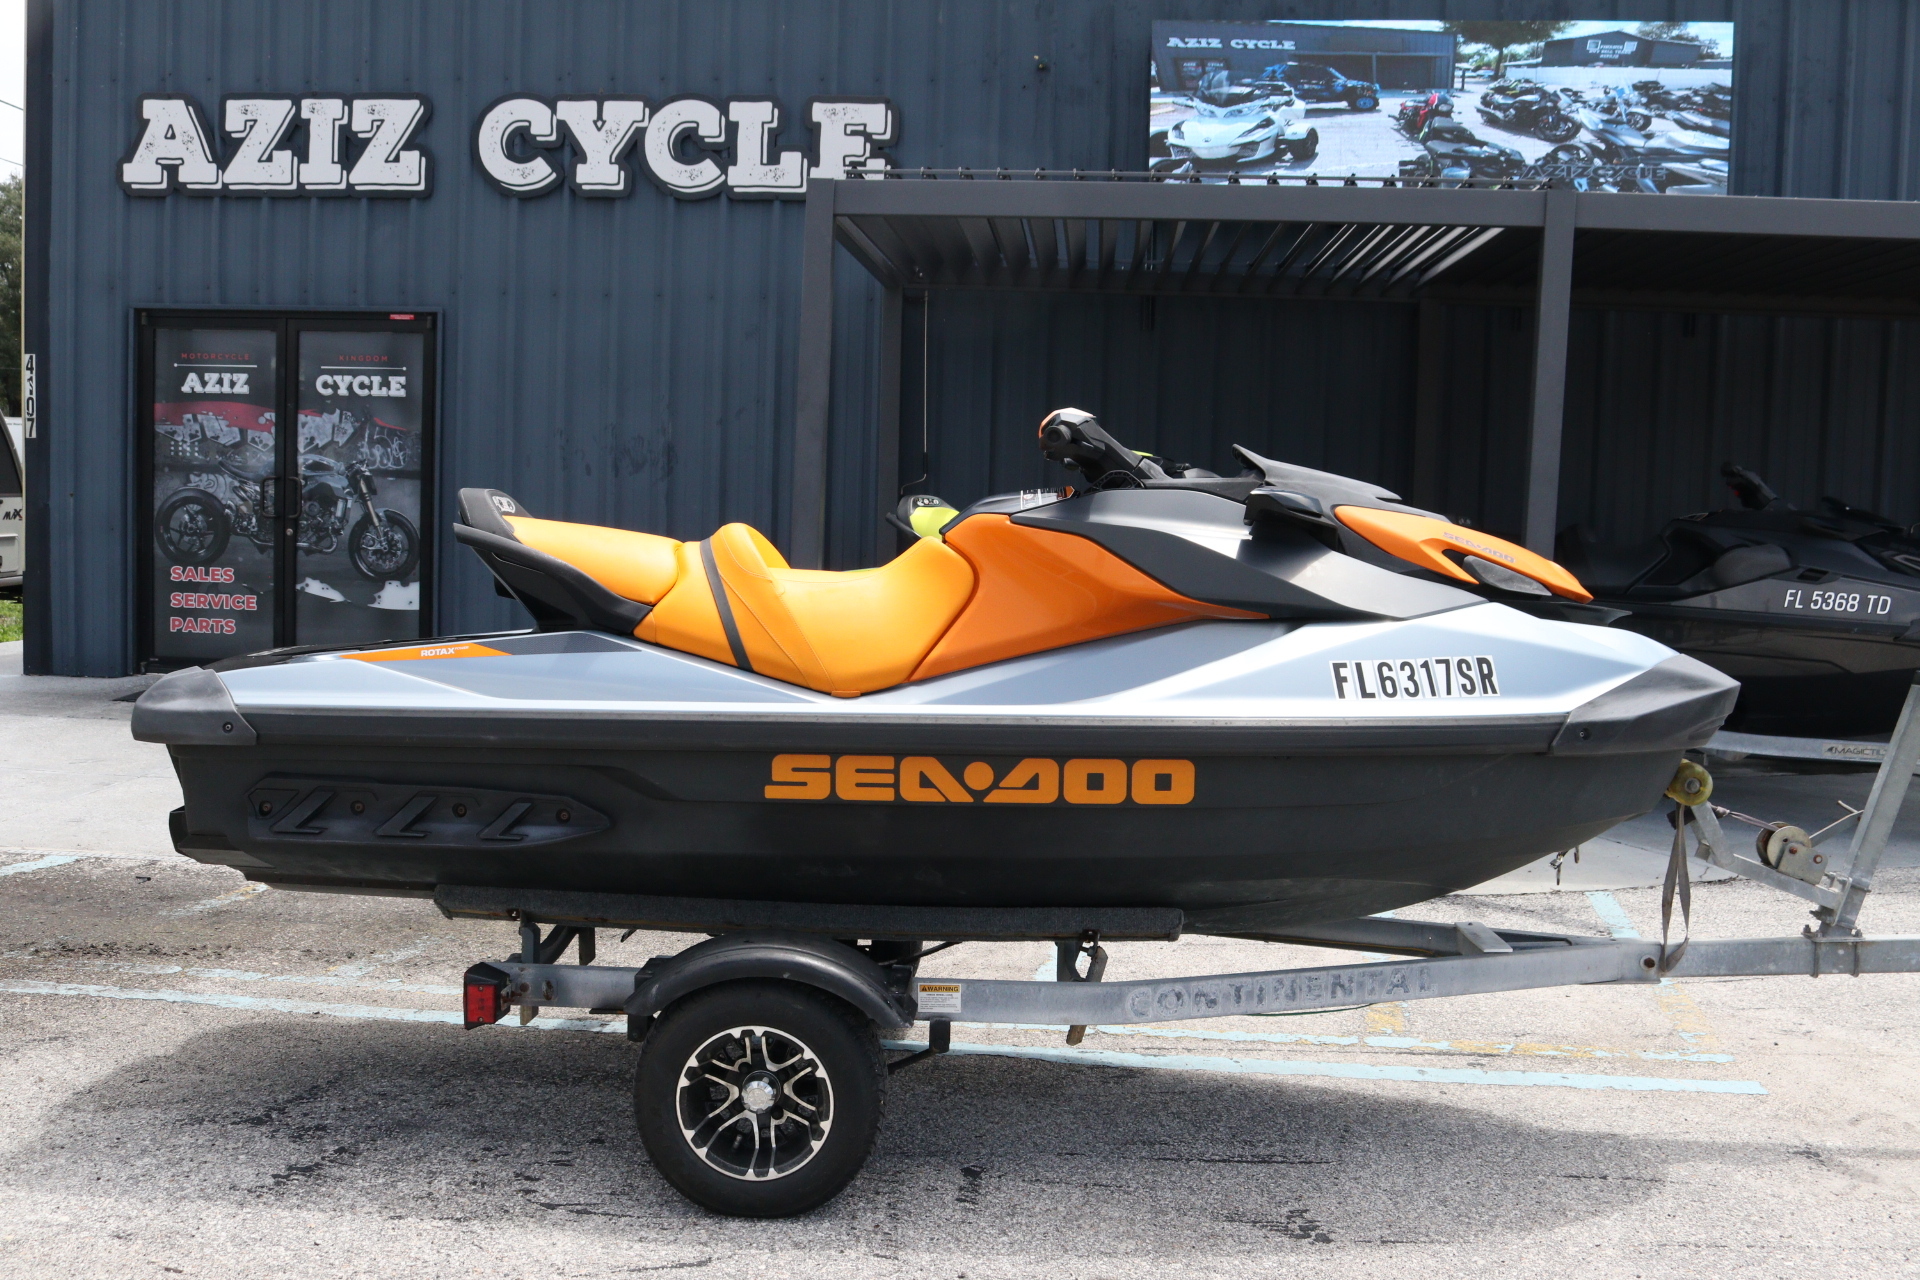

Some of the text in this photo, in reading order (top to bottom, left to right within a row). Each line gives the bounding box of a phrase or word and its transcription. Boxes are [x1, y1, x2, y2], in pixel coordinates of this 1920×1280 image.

[1166, 37, 1296, 50] AZIZ CYCLE
[122, 98, 892, 193] AZIZ CYCLE
[181, 372, 250, 394] AZIZ
[315, 375, 406, 397] CYCLE
[170, 565, 235, 584] SALES
[170, 592, 258, 611] SERVICE
[1784, 589, 1892, 615] FL 5368 TD
[170, 616, 237, 635] PARTS
[421, 648, 455, 657] ROTAX
[1332, 656, 1499, 700] FL6317SR
[1834, 746, 1888, 757] MAGICTIL
[1127, 966, 1437, 1019] CONTINENTAL
